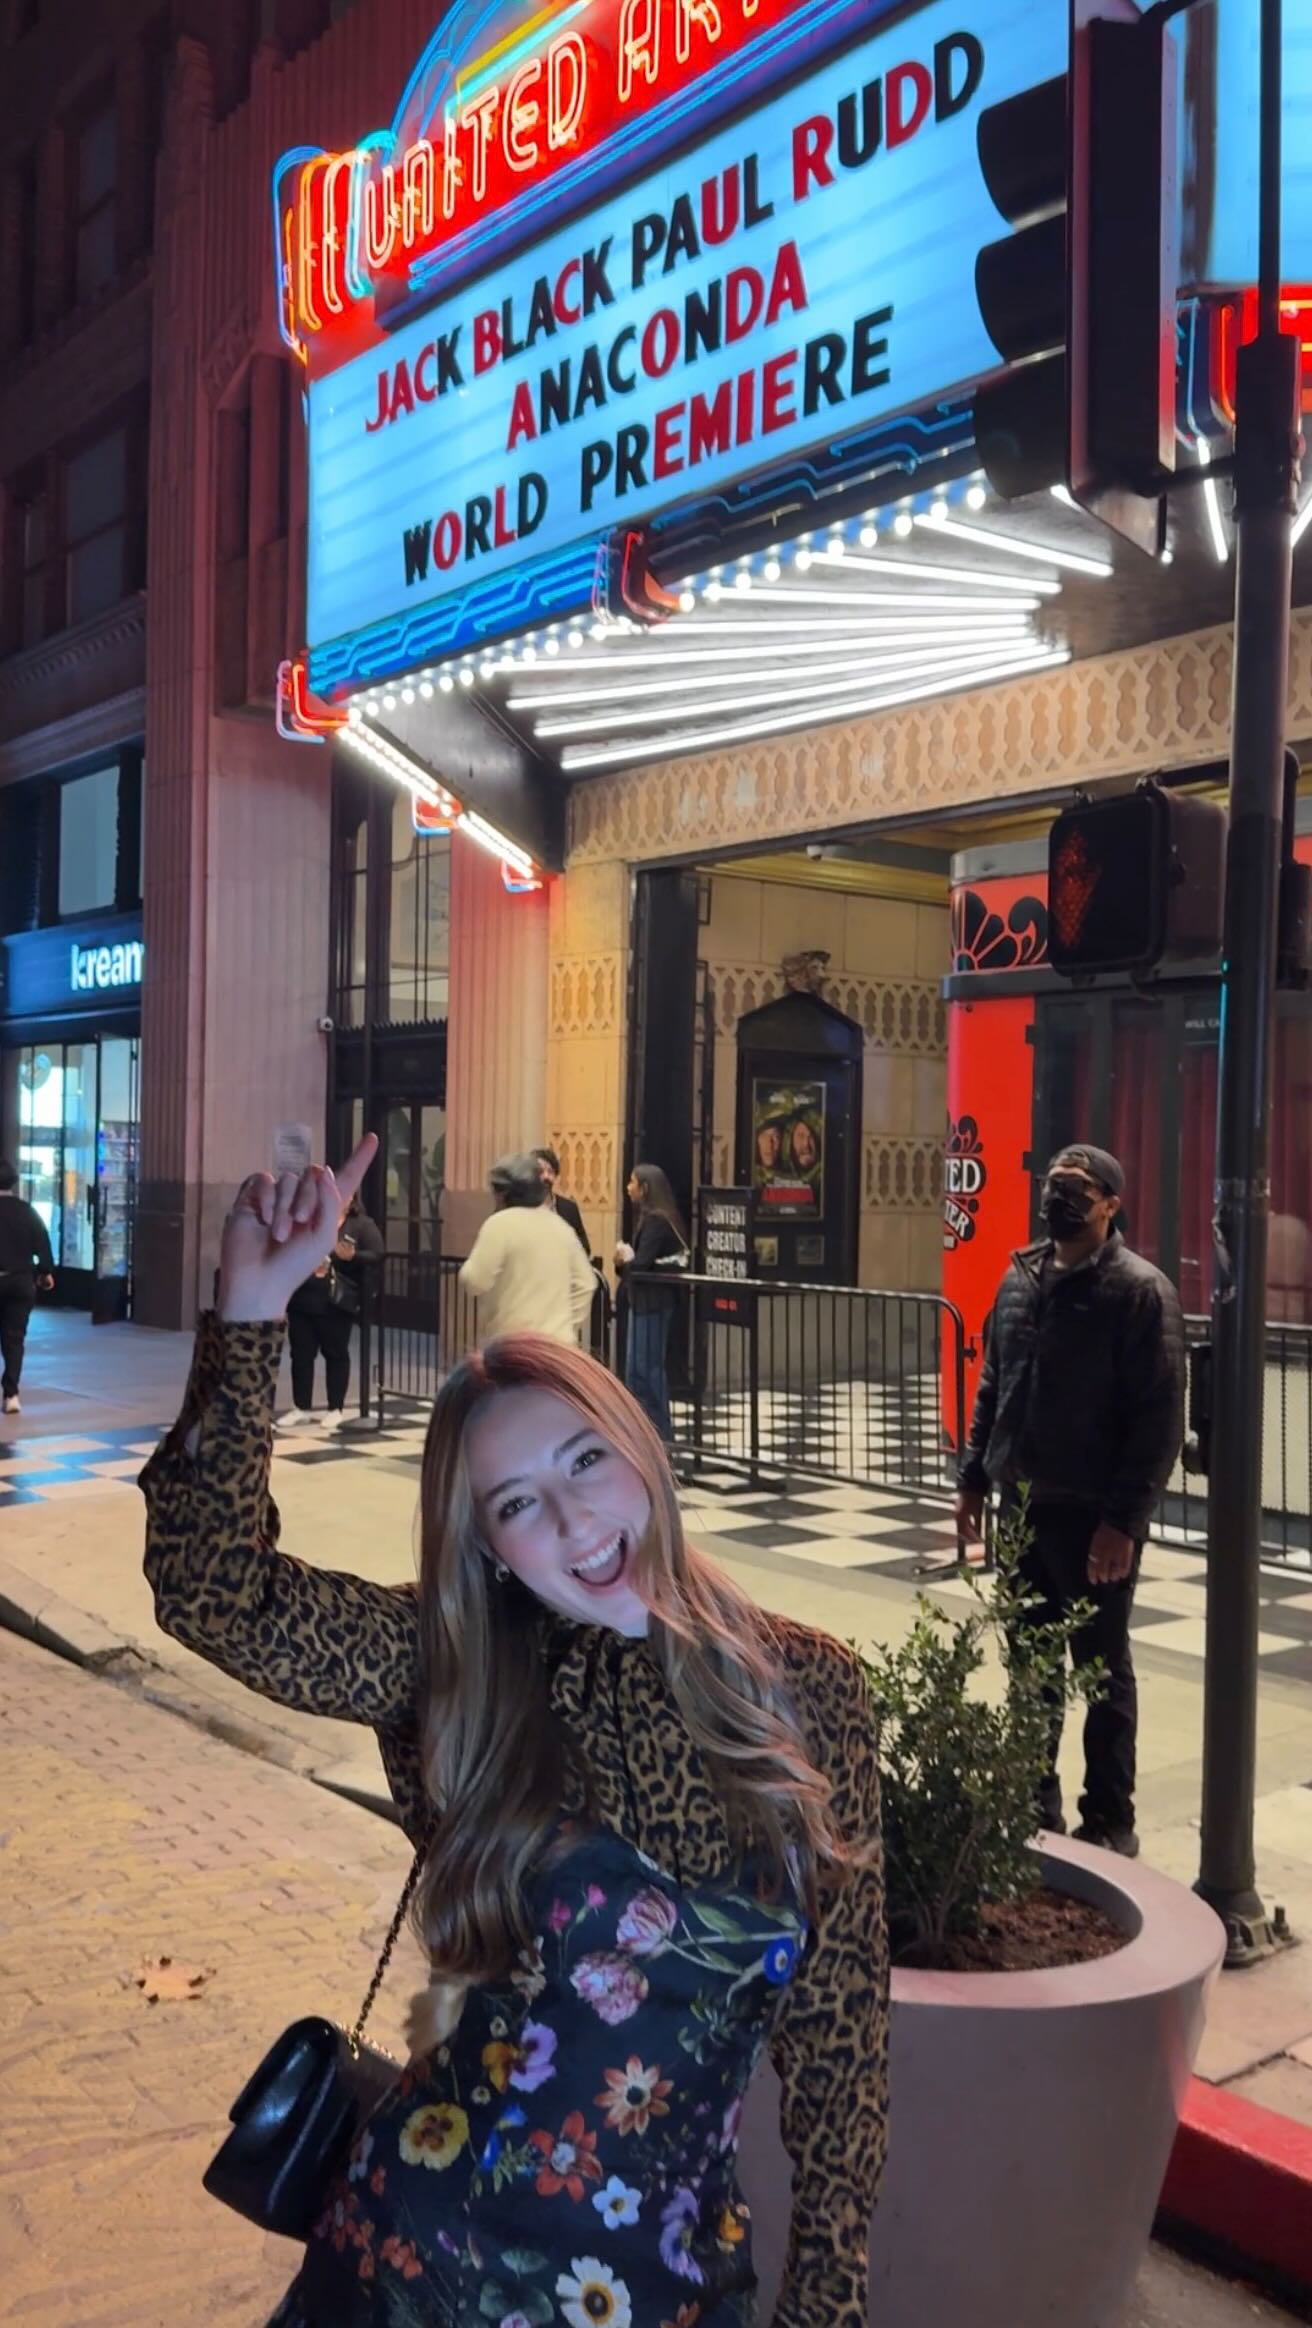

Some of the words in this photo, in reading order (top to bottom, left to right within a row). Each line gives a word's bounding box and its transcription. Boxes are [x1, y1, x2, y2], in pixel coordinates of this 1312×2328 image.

[364, 31, 587, 270] UNITED
[365, 323, 464, 433] JACK
[473, 235, 615, 377] BLACK
[632, 152, 774, 290] PAUL
[792, 31, 984, 203] RUDD
[403, 471, 548, 586] WORLD
[580, 305, 895, 513] PREMIERE
[506, 239, 808, 453] ANACONDA
[706, 1229, 747, 1254] CREATOR
